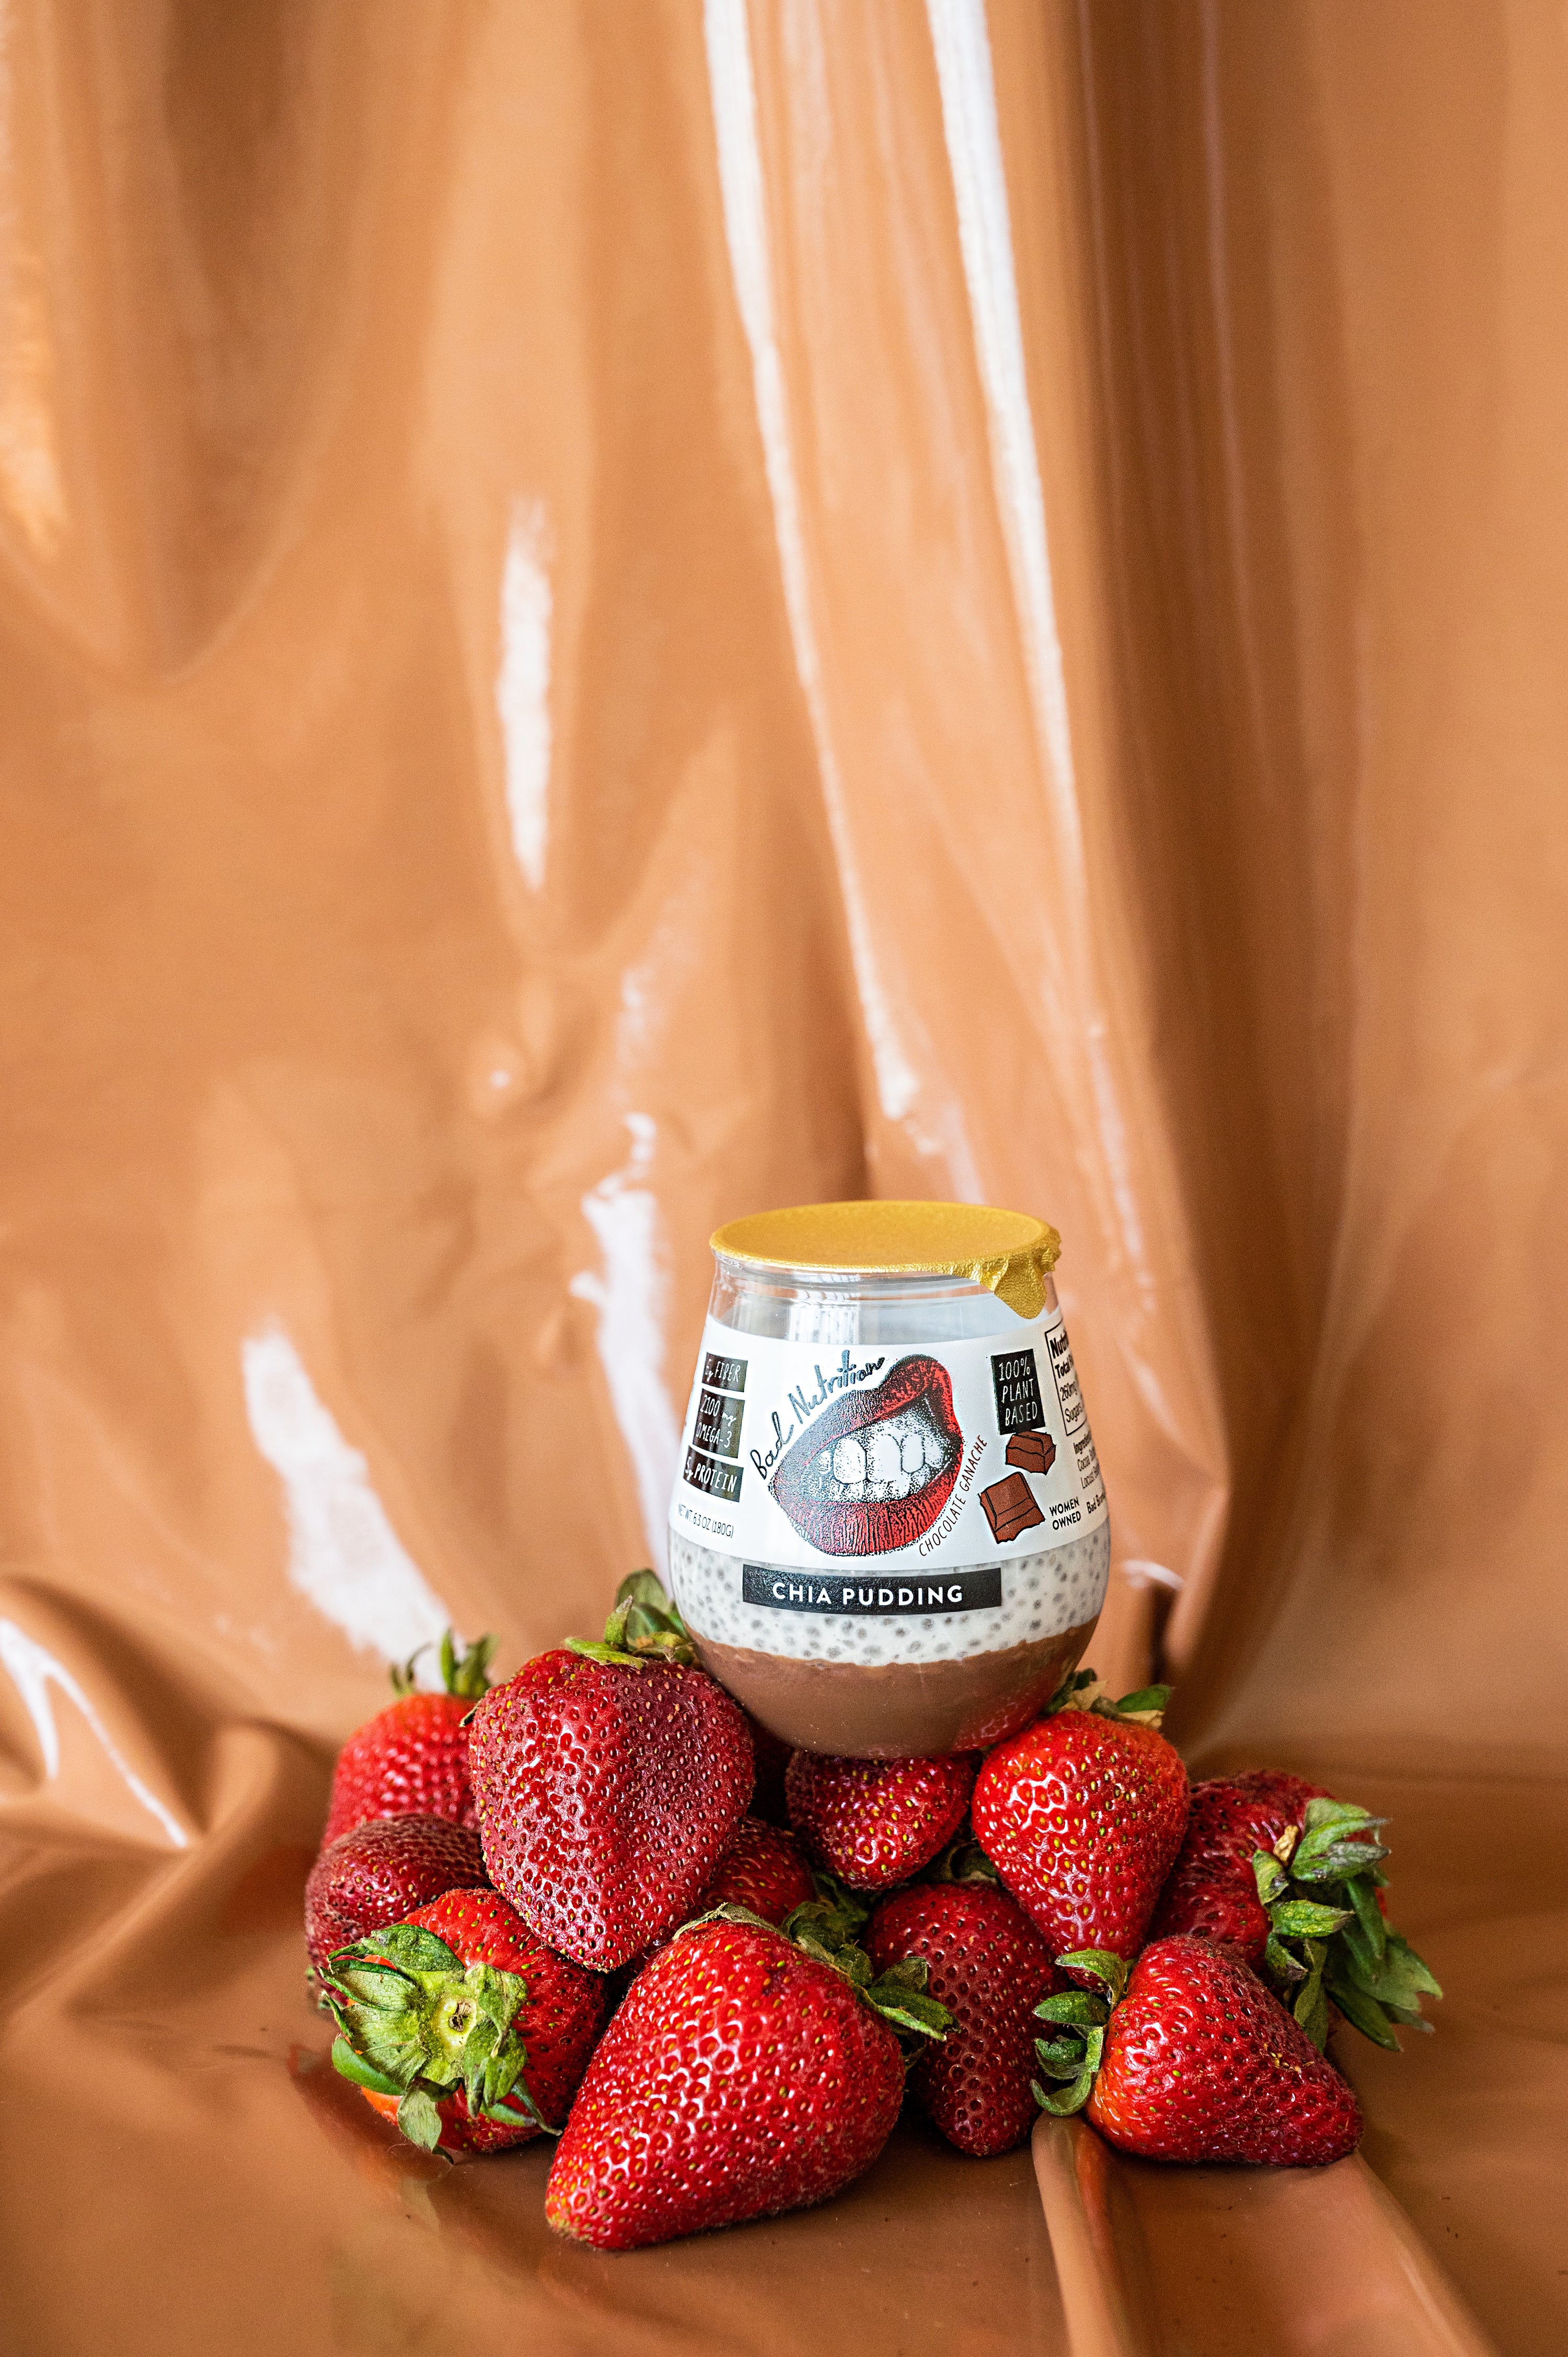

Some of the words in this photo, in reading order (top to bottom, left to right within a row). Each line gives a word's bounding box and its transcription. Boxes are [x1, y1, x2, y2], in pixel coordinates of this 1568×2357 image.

[714, 1361, 741, 1383] FIBER
[999, 1356, 1030, 1381] 100%
[1055, 1357, 1070, 1378] Total
[1001, 1378, 1033, 1403] PLANT
[700, 1394, 720, 1417] 2100
[722, 1411, 737, 1427] mg
[750, 1411, 794, 1479] Bad
[787, 1349, 885, 1424] Nutrition
[1005, 1401, 1037, 1426] BASED
[696, 1422, 732, 1448] OMEGA-3
[694, 1463, 737, 1493] PROTEIN
[919, 1493, 966, 1557] CHOCOLATE
[959, 1434, 987, 1492] GANACHE
[1050, 1496, 1080, 1516] WOMEN
[1087, 1498, 1097, 1514] Bad
[702, 1517, 711, 1531] OZ
[711, 1520, 734, 1538] (180G)
[1053, 1511, 1081, 1530] OWNED
[773, 1582, 832, 1604] CHIA
[843, 1585, 963, 1606] PUDDING
